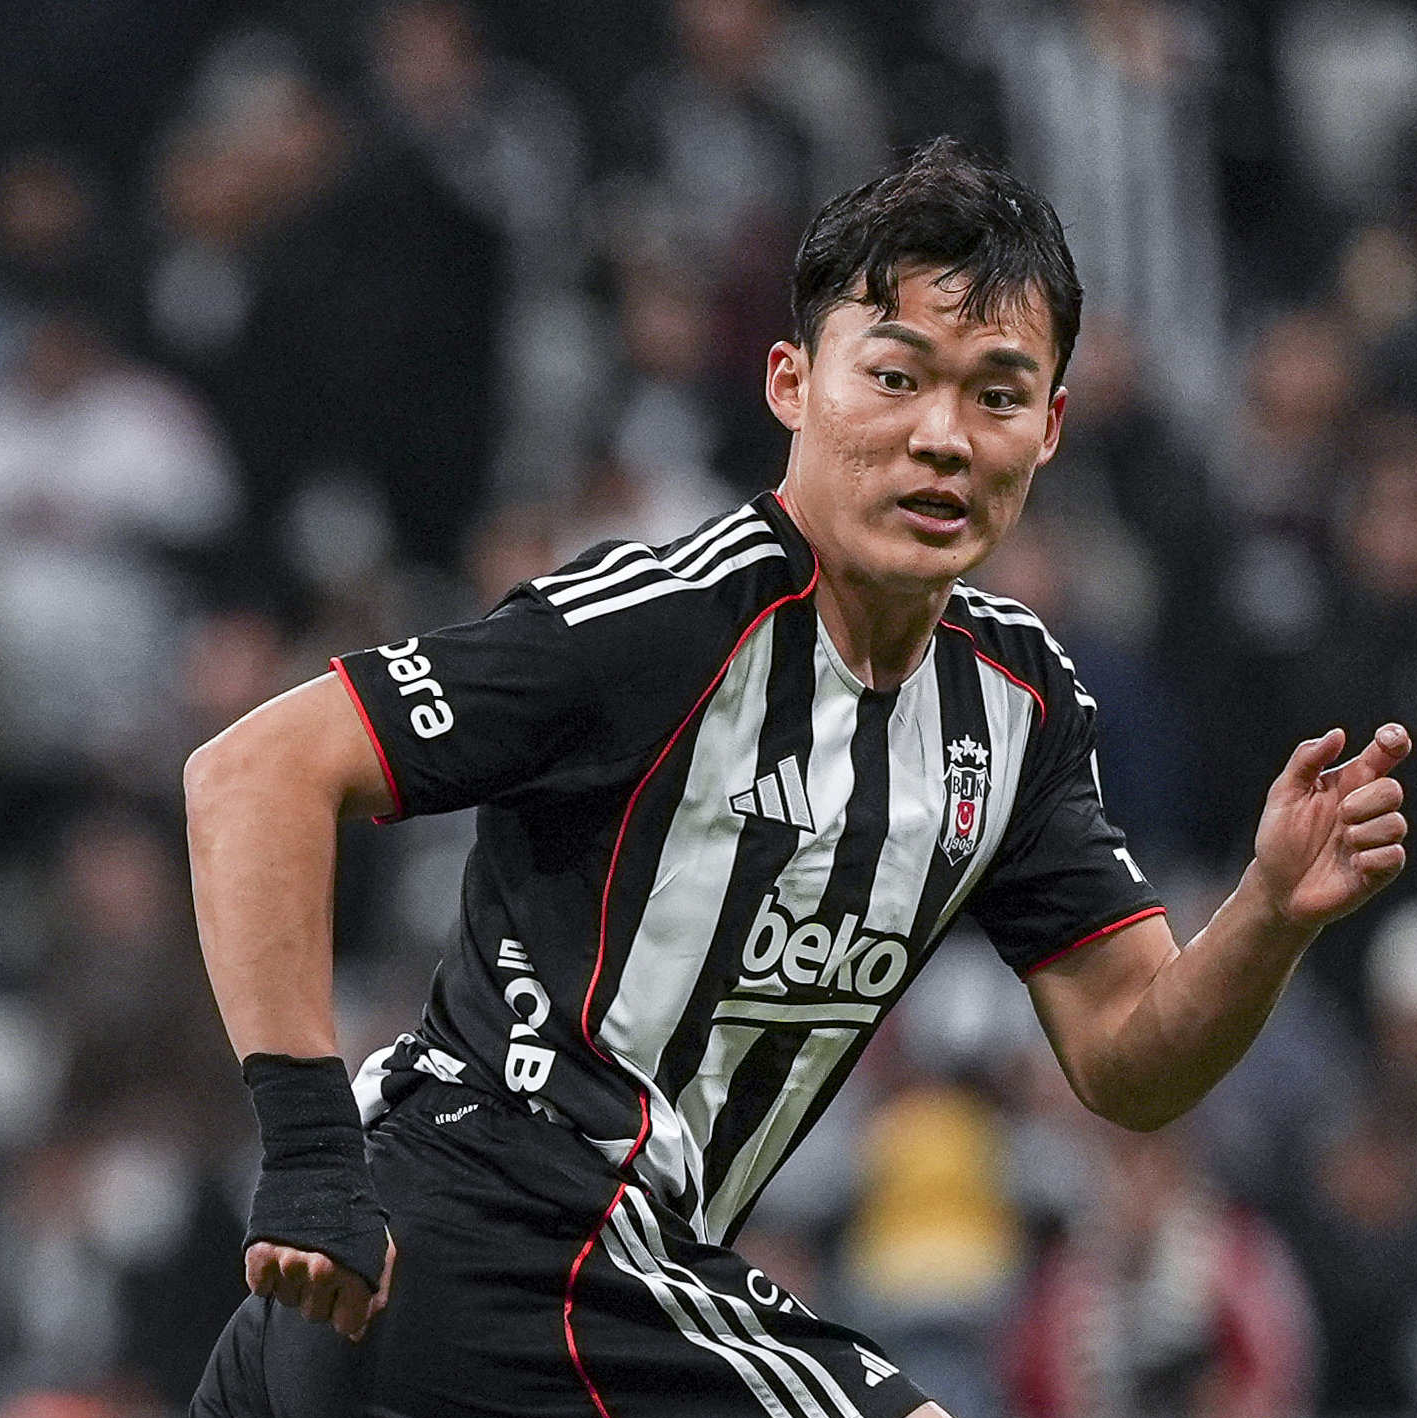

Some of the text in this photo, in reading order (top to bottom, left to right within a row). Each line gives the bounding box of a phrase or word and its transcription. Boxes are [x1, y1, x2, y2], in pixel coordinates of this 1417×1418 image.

[953, 777, 983, 797] BJK
[946, 837, 974, 852] 1903
[741, 894, 908, 998] beko
